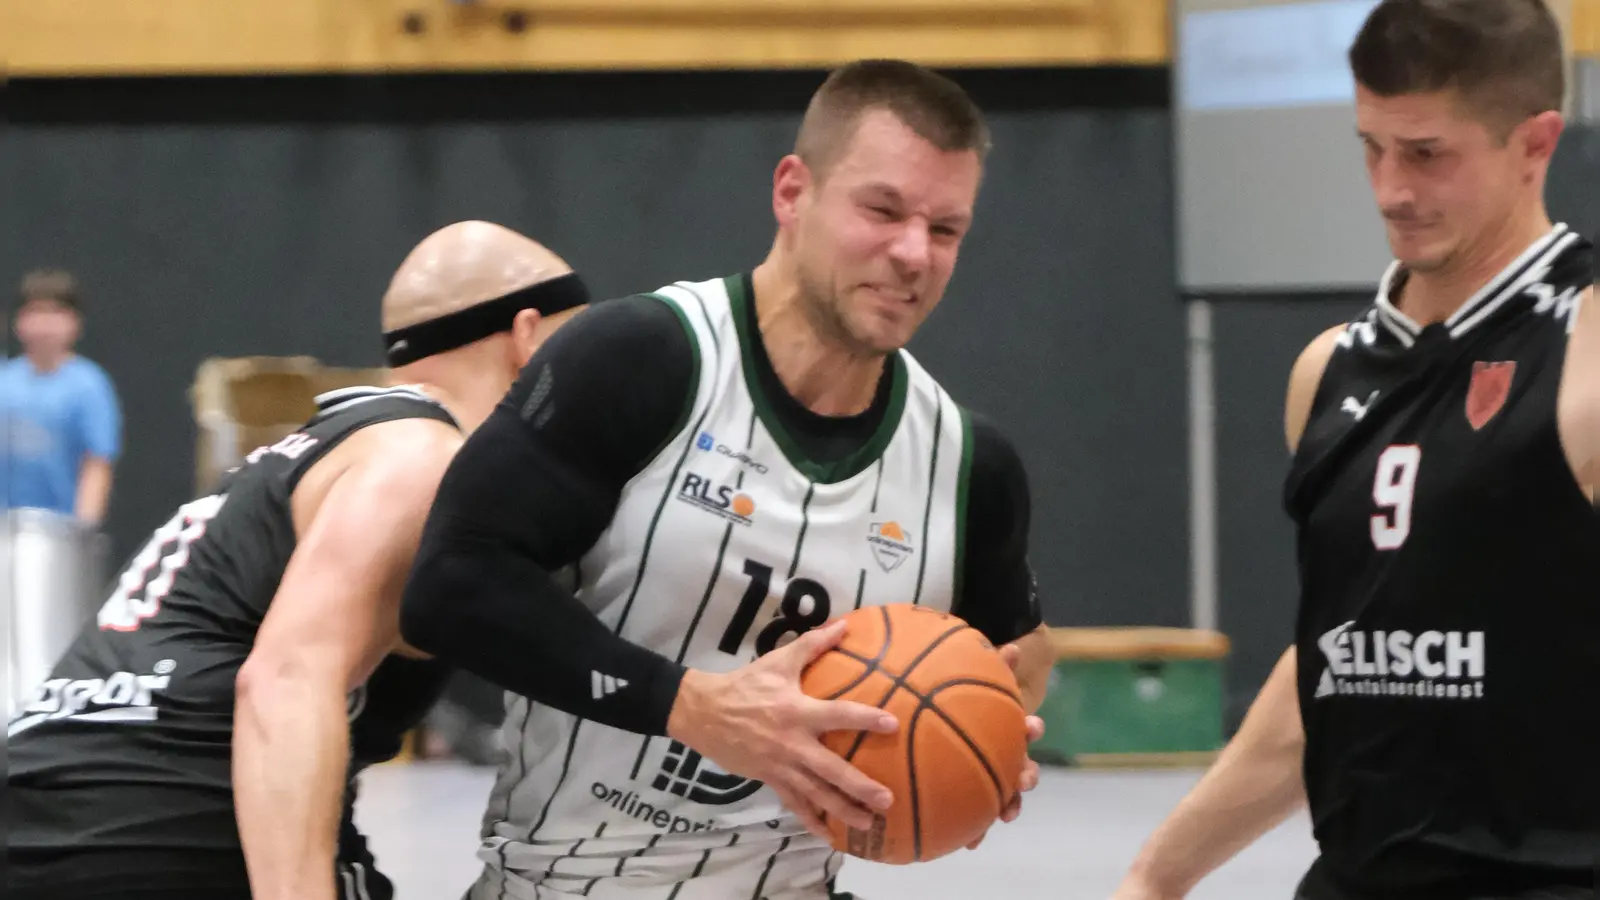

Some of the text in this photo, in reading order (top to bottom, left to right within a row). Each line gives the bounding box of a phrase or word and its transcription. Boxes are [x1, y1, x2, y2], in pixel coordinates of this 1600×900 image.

[681, 471, 733, 510] RLS
[1370, 444, 1422, 551] 9
[717, 557, 832, 659] 18
[591, 781, 780, 834] onlinepri
